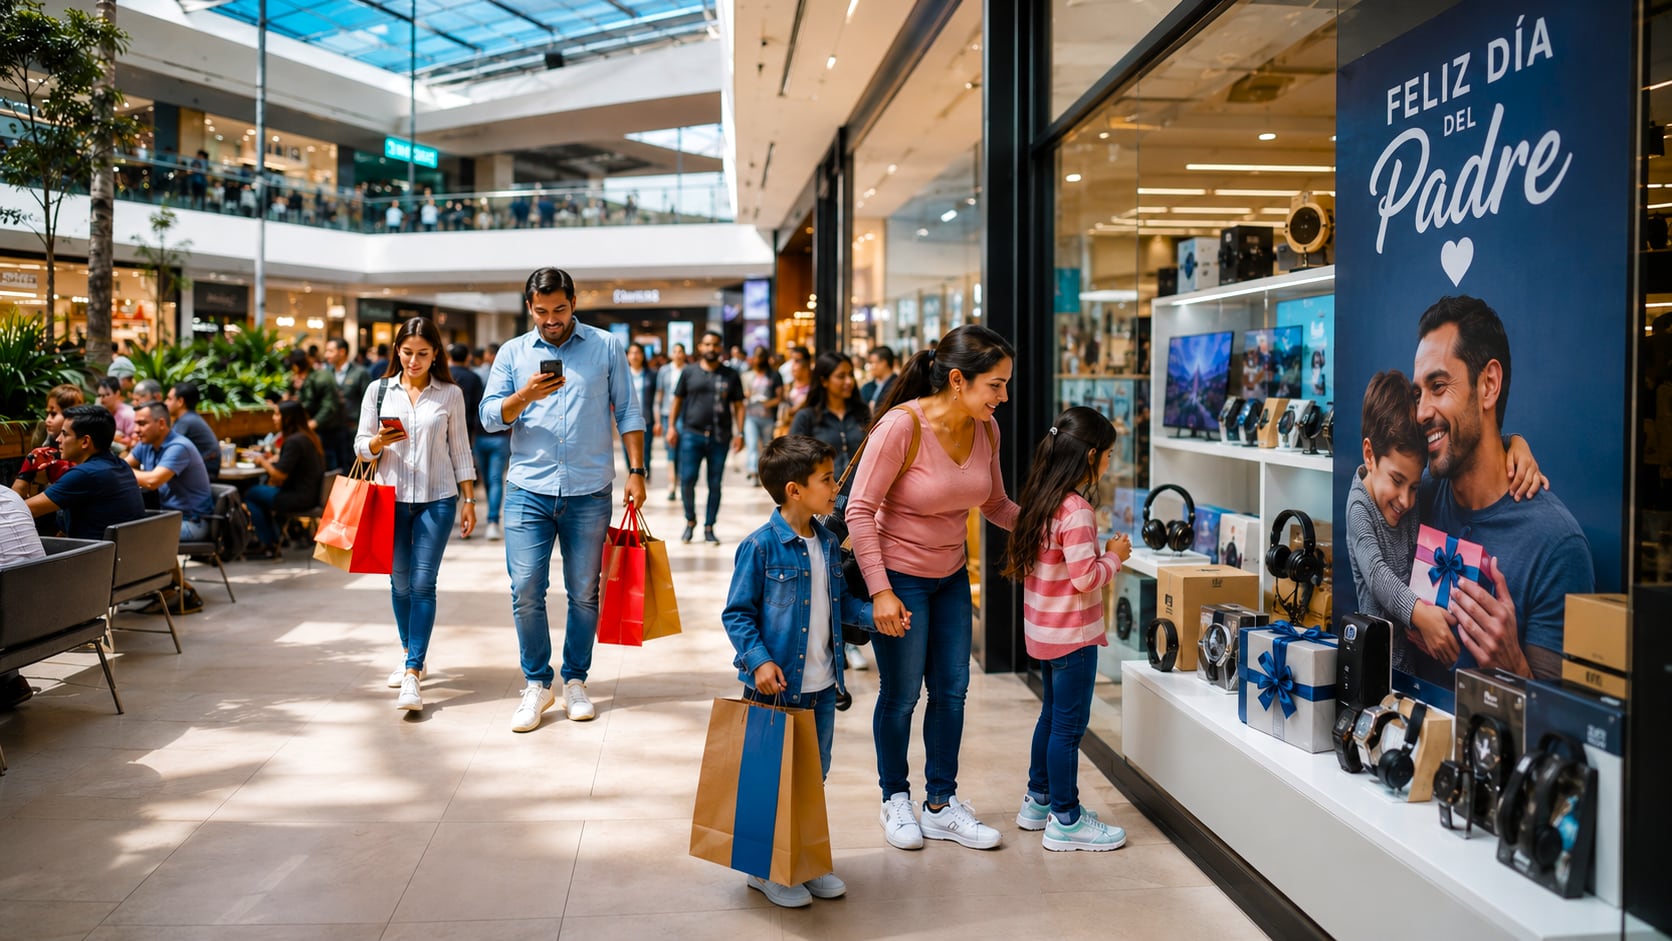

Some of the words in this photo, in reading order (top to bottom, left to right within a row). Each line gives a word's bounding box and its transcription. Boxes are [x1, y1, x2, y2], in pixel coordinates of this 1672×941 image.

[1387, 52, 1471, 126] FELIZ
[1487, 14, 1553, 84] DÍA
[1443, 106, 1476, 137] DEL
[1369, 102, 1573, 254] Padre
